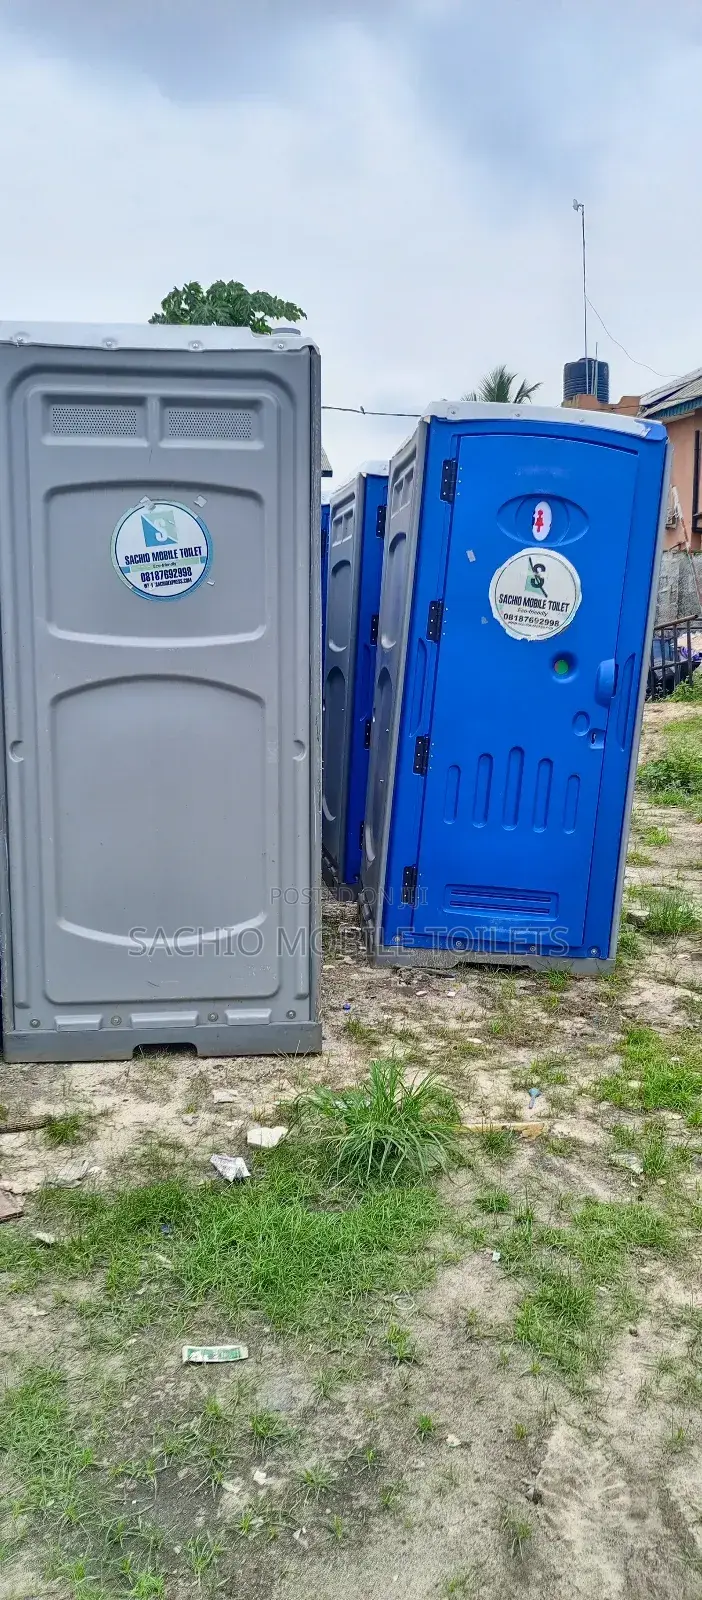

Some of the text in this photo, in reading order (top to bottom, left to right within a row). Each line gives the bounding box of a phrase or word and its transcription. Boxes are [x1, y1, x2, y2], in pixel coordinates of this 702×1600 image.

[124, 546, 202, 565] SACHIO MOBILE TOILET
[141, 567, 192, 582] 08187692998
[499, 594, 570, 612] SACHIO MOBILE TOILET
[504, 613, 559, 626] 08187692998
[517, 607, 549, 617] Eco-friendly
